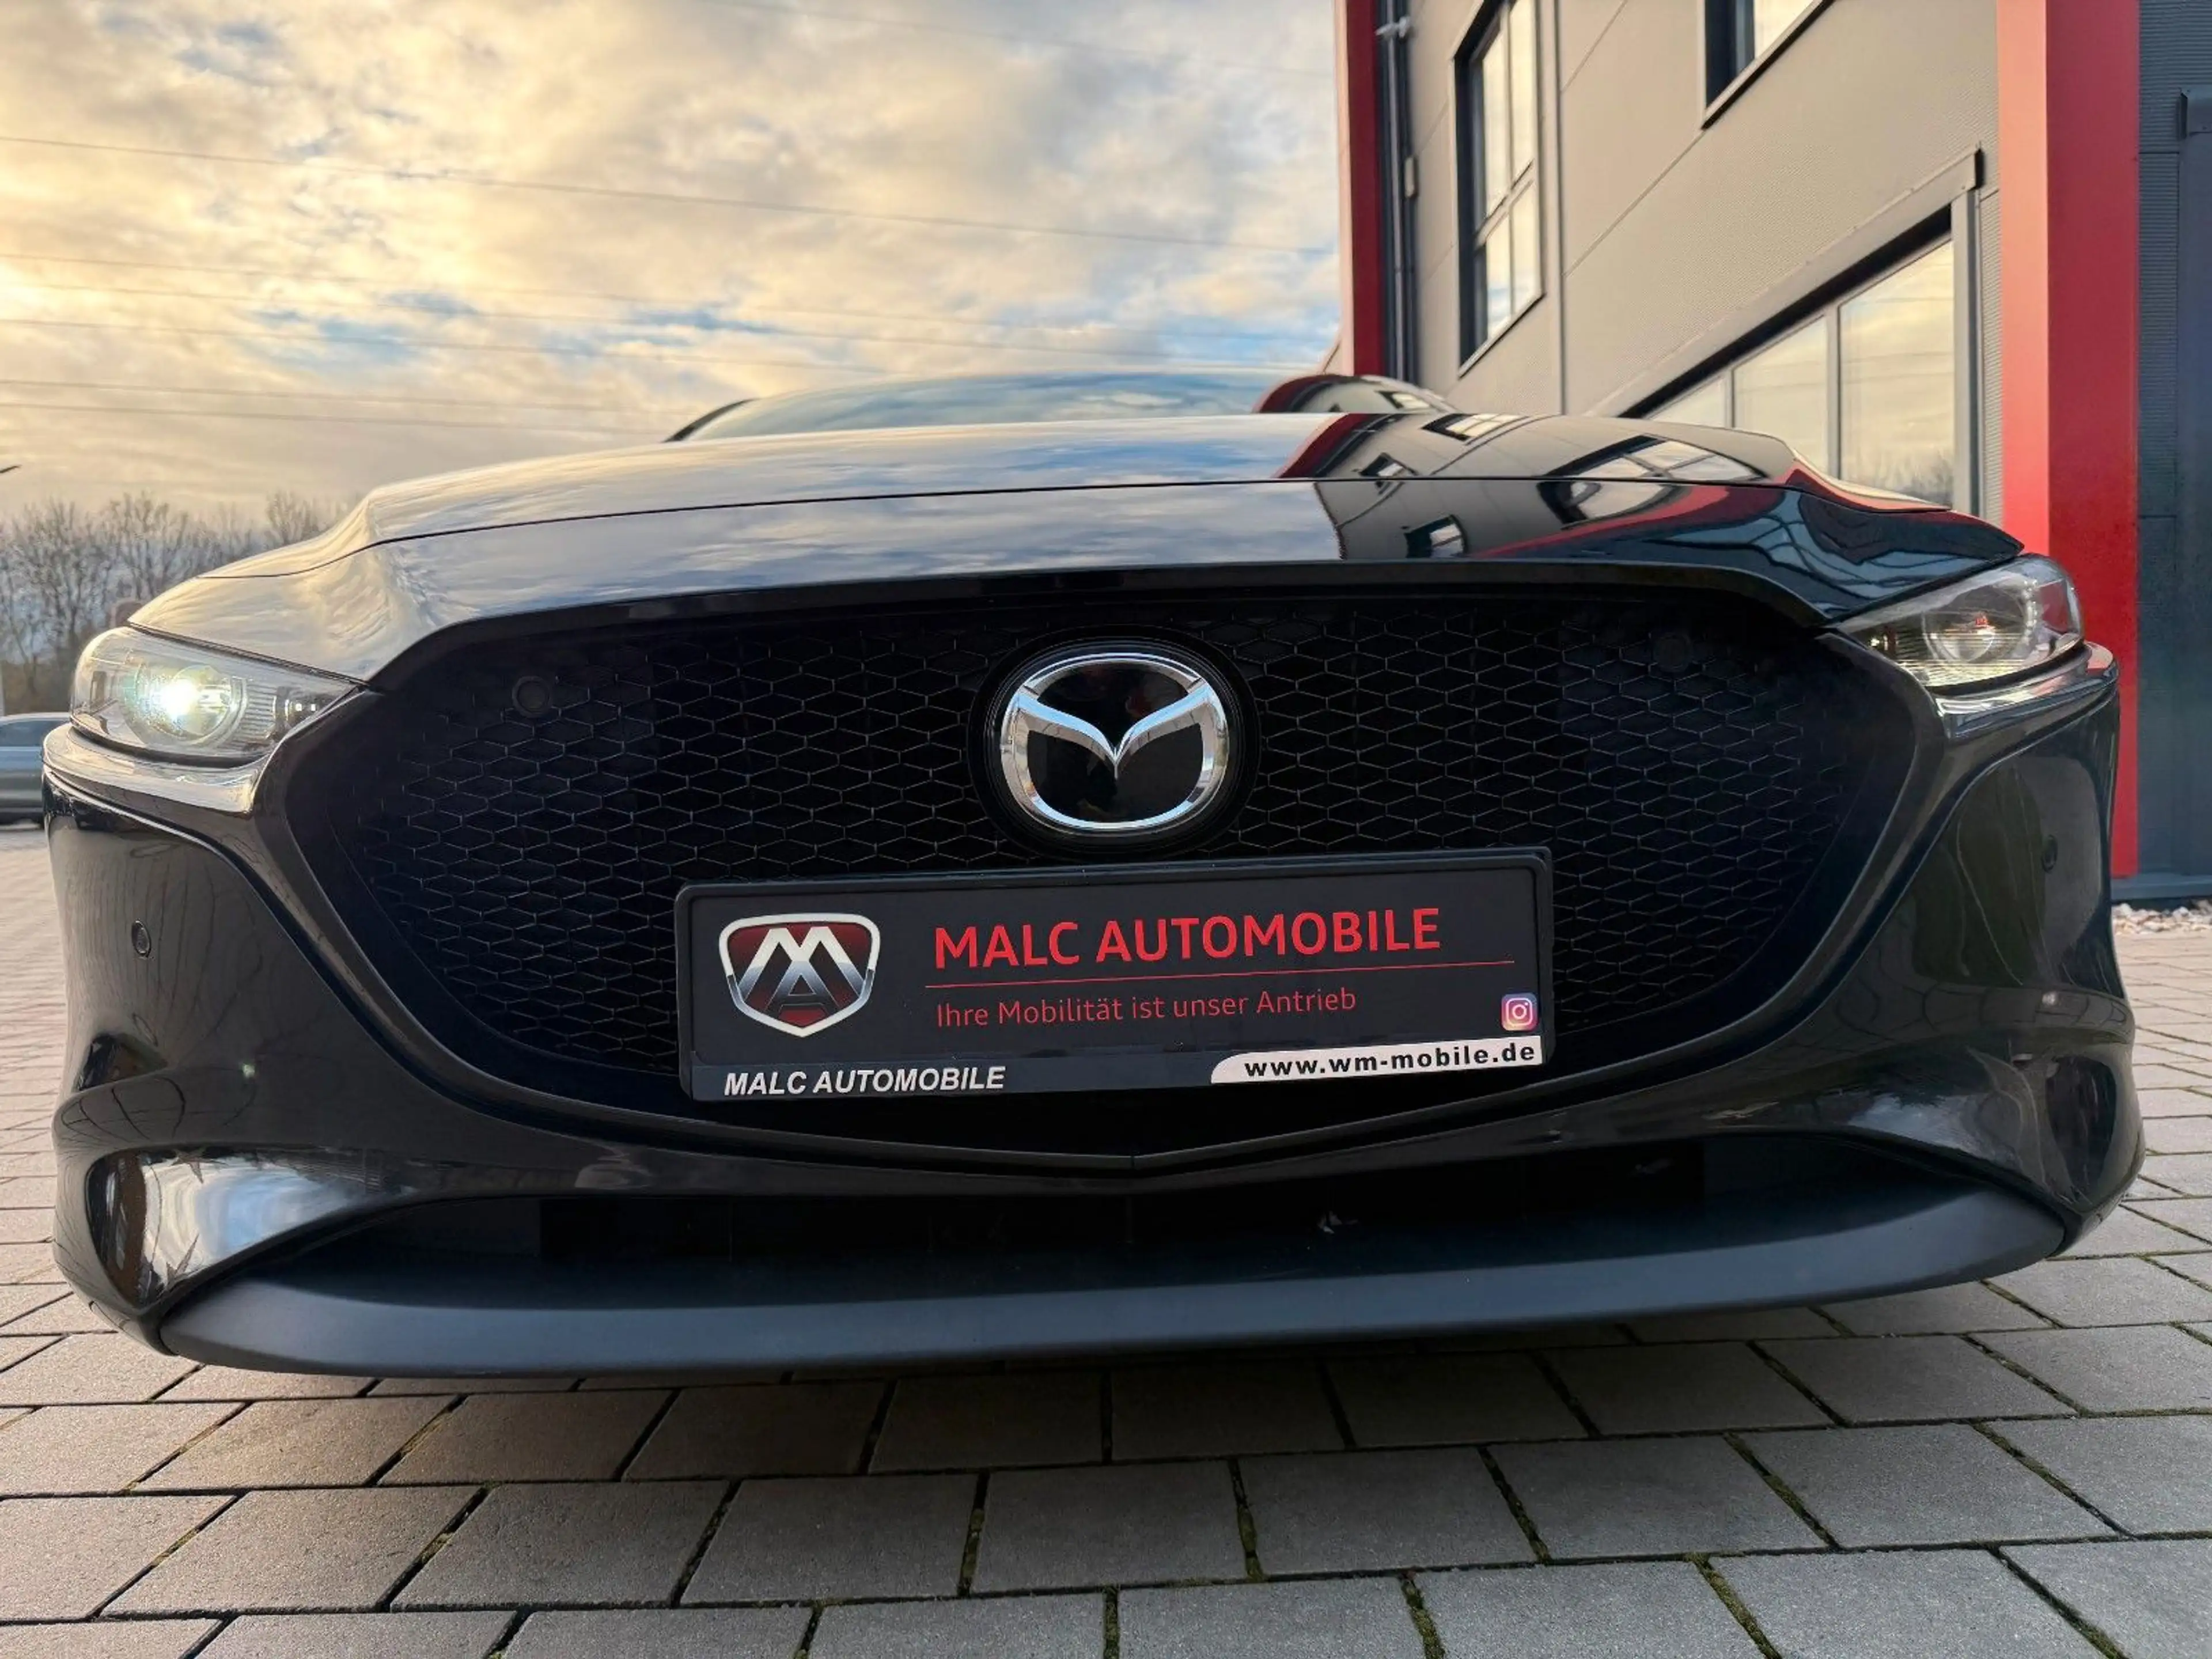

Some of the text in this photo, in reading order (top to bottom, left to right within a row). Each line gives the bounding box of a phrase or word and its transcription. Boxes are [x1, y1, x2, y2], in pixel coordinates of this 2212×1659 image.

[934, 907, 1440, 969] MALC AUTOMOBILE
[937, 987, 1357, 1027] Ihre Mobilität ist unser Antrieb
[1244, 1043, 1535, 1077] www.wm-mobile.de
[724, 1066, 1006, 1096] MALC AUTOMOBILE
